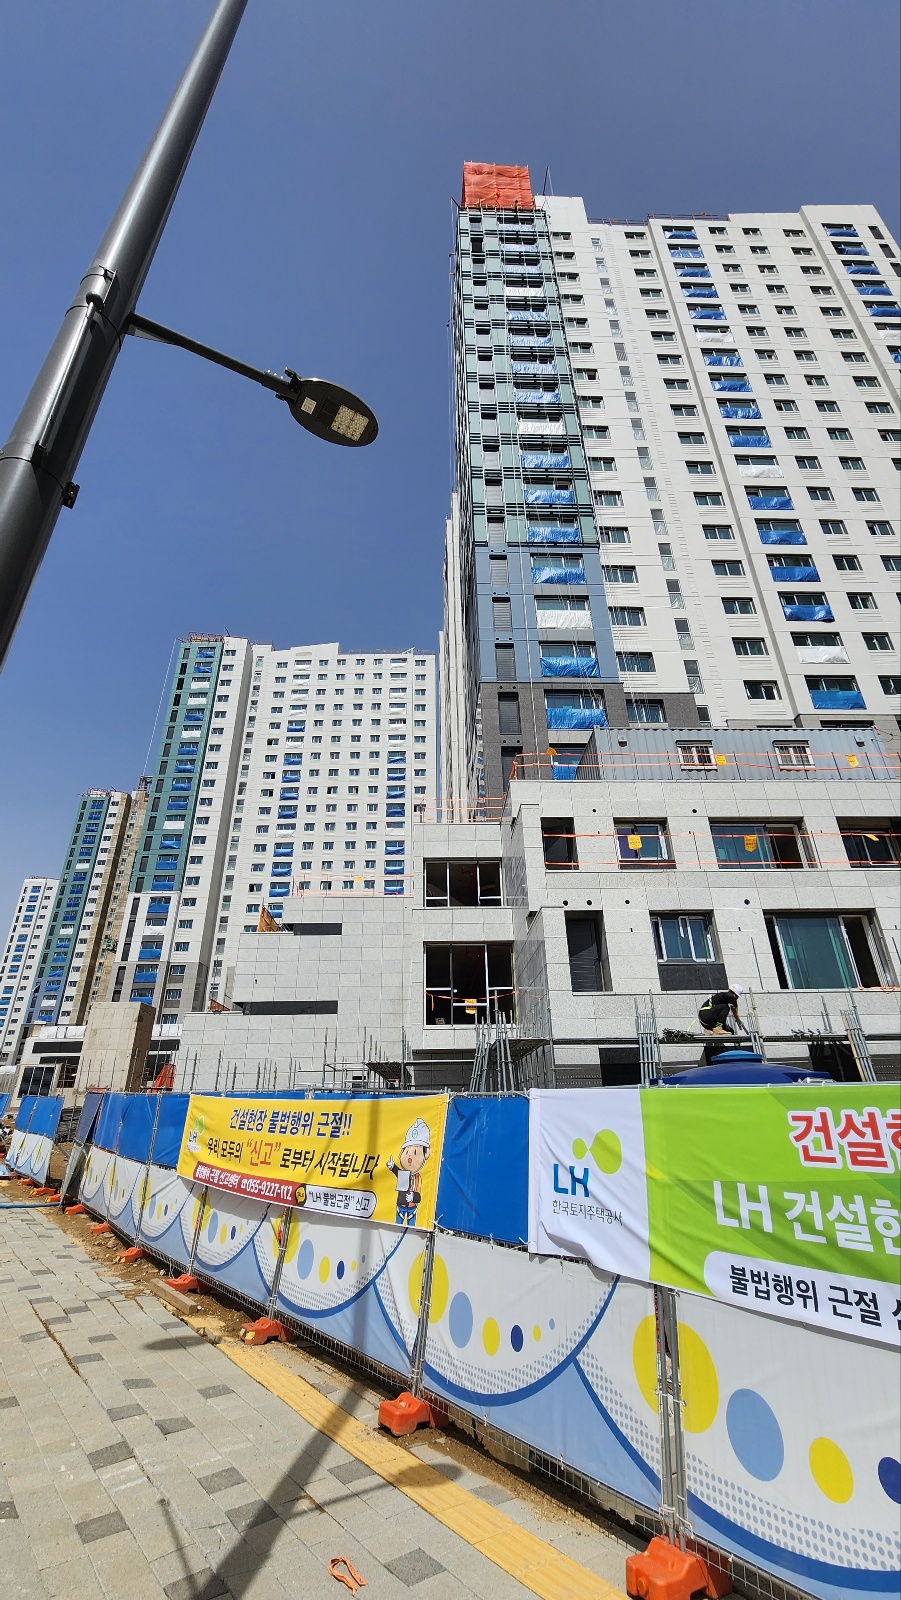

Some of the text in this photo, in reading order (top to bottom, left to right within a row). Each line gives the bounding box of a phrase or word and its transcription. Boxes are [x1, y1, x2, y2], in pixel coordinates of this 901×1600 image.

[230, 1108, 353, 1139] 건설현장 불법행위 근절!!
[790, 1110, 900, 1169] 건설
[208, 1138, 220, 1158] 우리
[221, 1140, 243, 1163] 모두의
[280, 1148, 316, 1173] 로부터
[315, 1151, 381, 1181] 시작됩니다
[246, 1179, 292, 1200] 055-9227-112
[553, 1163, 590, 1198] LH
[355, 1196, 371, 1212] 신고
[552, 1199, 623, 1227] 한국토지주택공사
[713, 1180, 773, 1233] LH
[728, 1263, 819, 1313] 불법행위
[828, 1284, 882, 1327] 근절
